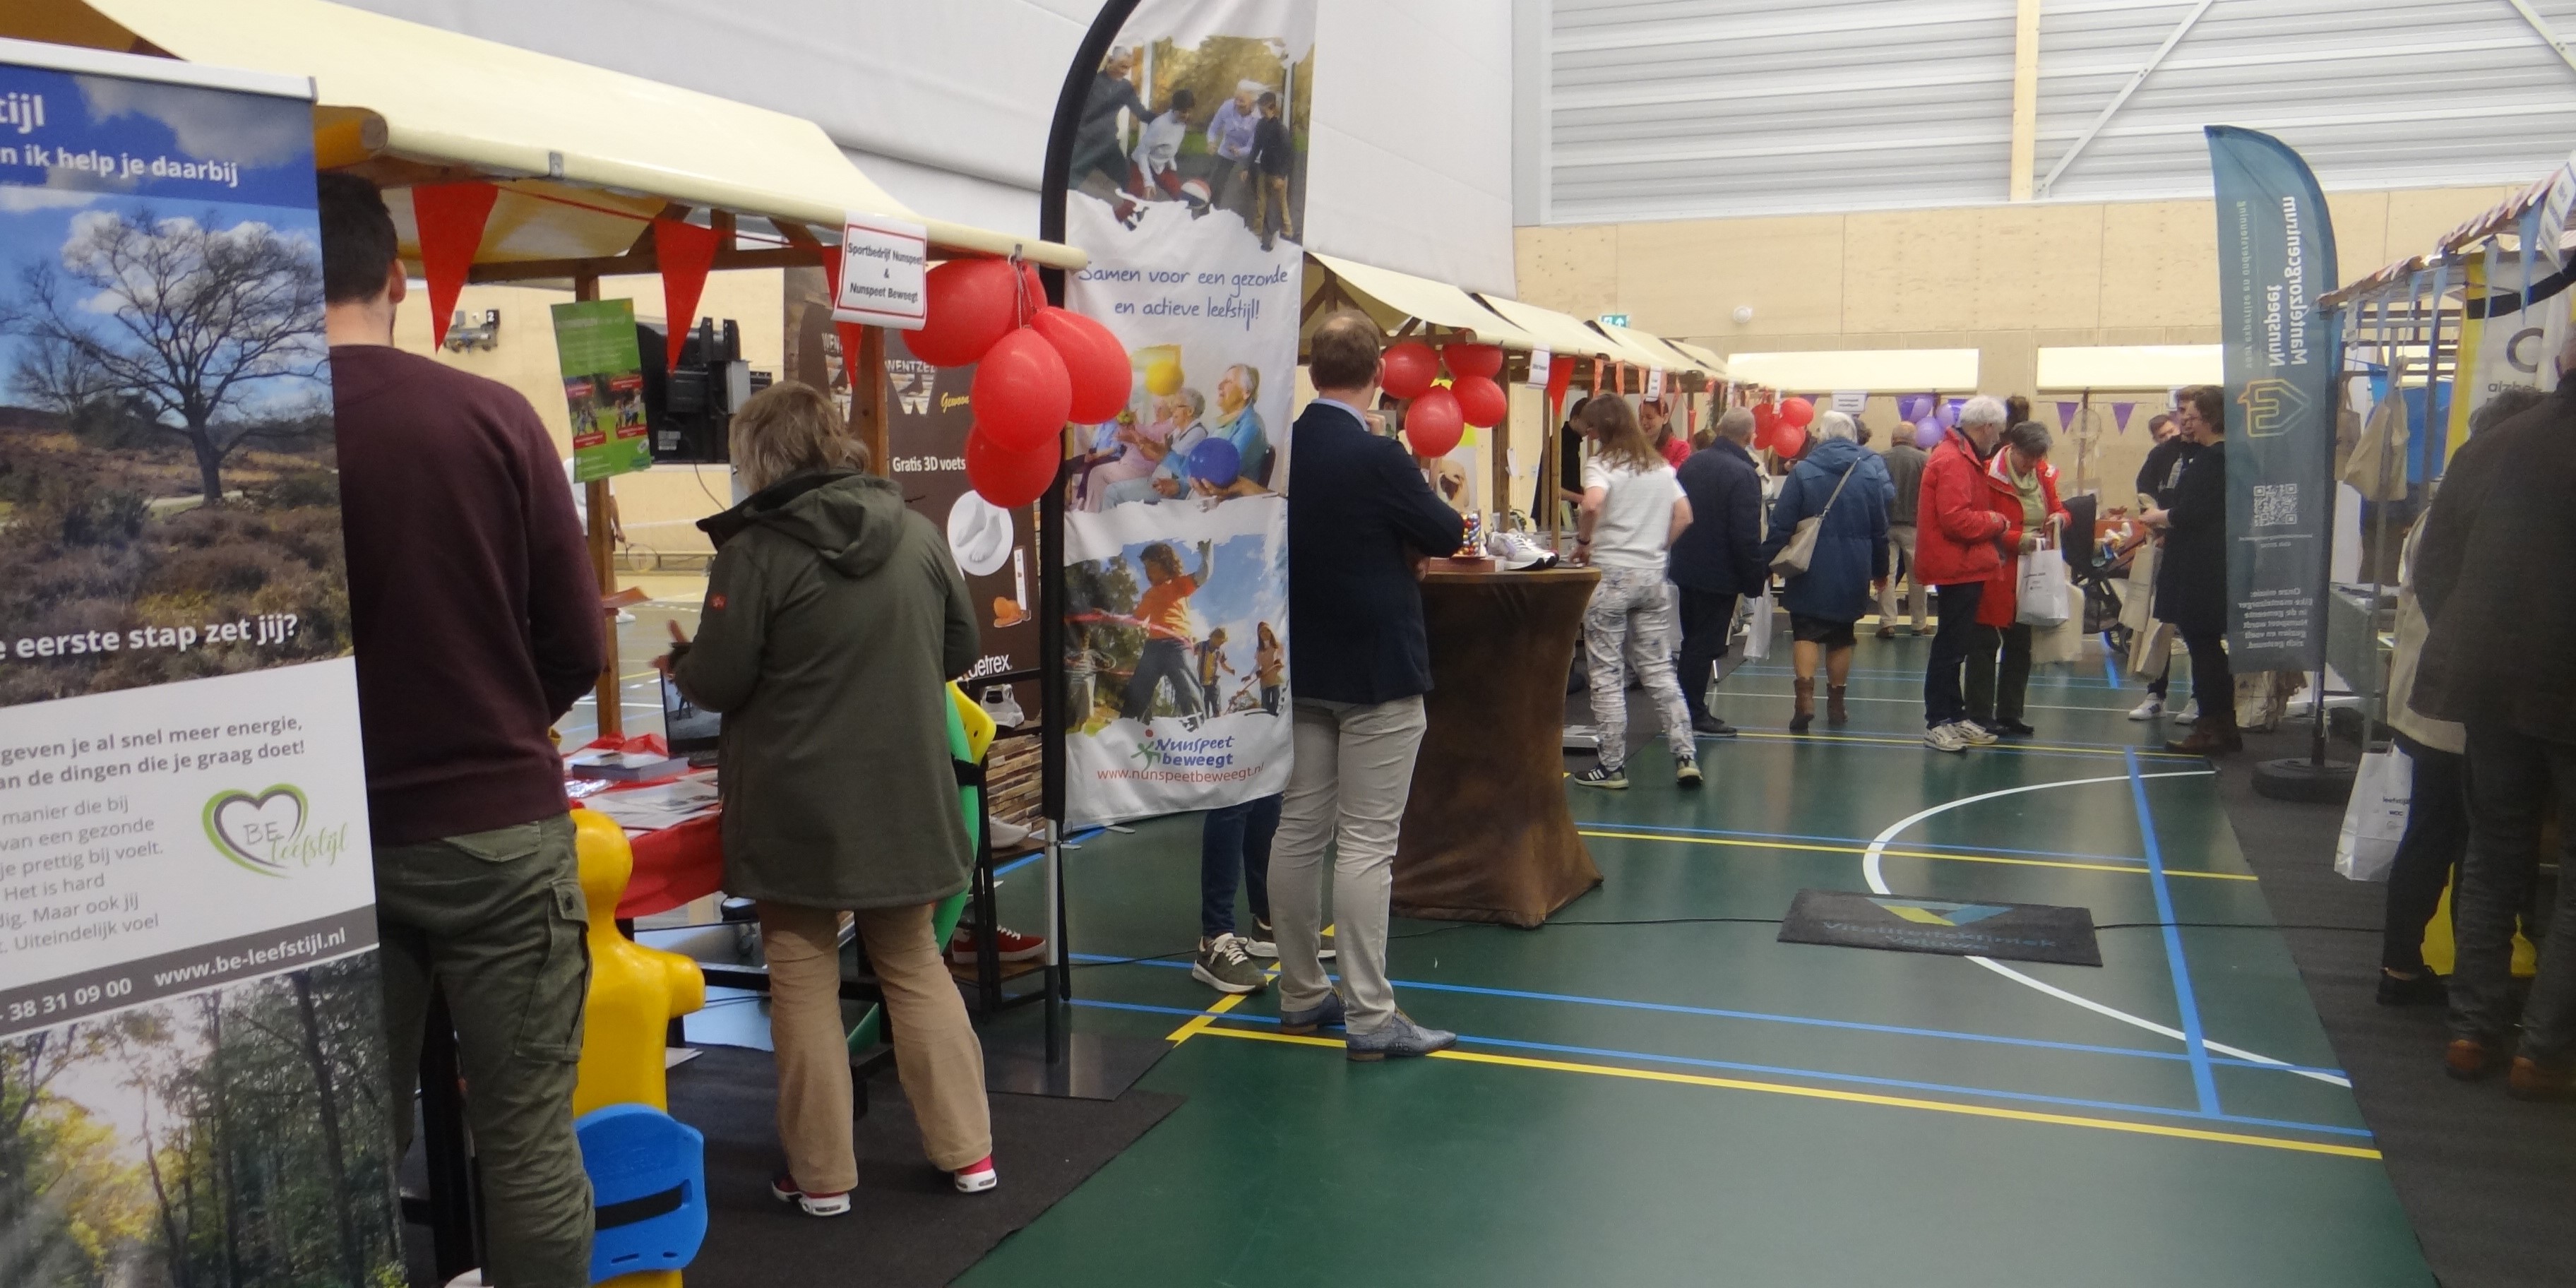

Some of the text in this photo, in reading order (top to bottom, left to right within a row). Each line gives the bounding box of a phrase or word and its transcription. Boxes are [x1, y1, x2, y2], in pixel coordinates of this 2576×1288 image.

[24, 143, 51, 167] ik
[56, 145, 115, 177] help
[119, 152, 145, 179] je
[152, 155, 239, 188] daarbij
[848, 242, 923, 267] Sportbedrijf Nunspeet
[883, 268, 890, 278] &
[1078, 262, 1289, 299] Samen voor een gezonde
[849, 282, 919, 304] Nunspeet Beweegt
[1114, 297, 1260, 331] en actieve leefstijl!
[892, 456, 922, 472] Gratis
[924, 455, 938, 472] 3D
[16, 629, 120, 658] eerste
[129, 624, 197, 652] stap
[205, 618, 251, 643] zet
[256, 613, 298, 645] jij?
[1, 715, 303, 767] geven je al snel meer energie,
[1155, 736, 1235, 754] Nunspeet
[28, 770, 54, 787] de
[60, 762, 132, 783] dingen
[138, 756, 169, 773] die
[173, 752, 191, 773] je
[198, 748, 253, 770] graag
[258, 740, 306, 759] doet!
[1097, 763, 1265, 783] www.nunspeetbeweegt.nl
[1162, 753, 1234, 768] beweegt
[2, 794, 129, 826] manier die bij
[39, 830, 73, 847] een
[78, 817, 155, 845] gezonde
[243, 821, 285, 846] BE
[23, 852, 85, 878] prettig
[89, 847, 111, 866] bij
[115, 840, 164, 860] voelt.
[4, 873, 105, 902] Het is hard
[32, 904, 80, 923] Maar
[85, 895, 120, 915] ook
[124, 891, 139, 912] jij
[13, 920, 118, 951] Uiteindelijk
[122, 913, 159, 933] voel
[9, 999, 37, 1022] 38
[42, 991, 68, 1015] 31
[74, 984, 100, 1007] 09
[105, 976, 133, 1000] 00
[153, 927, 346, 987] www.be-leefstijl.nl
